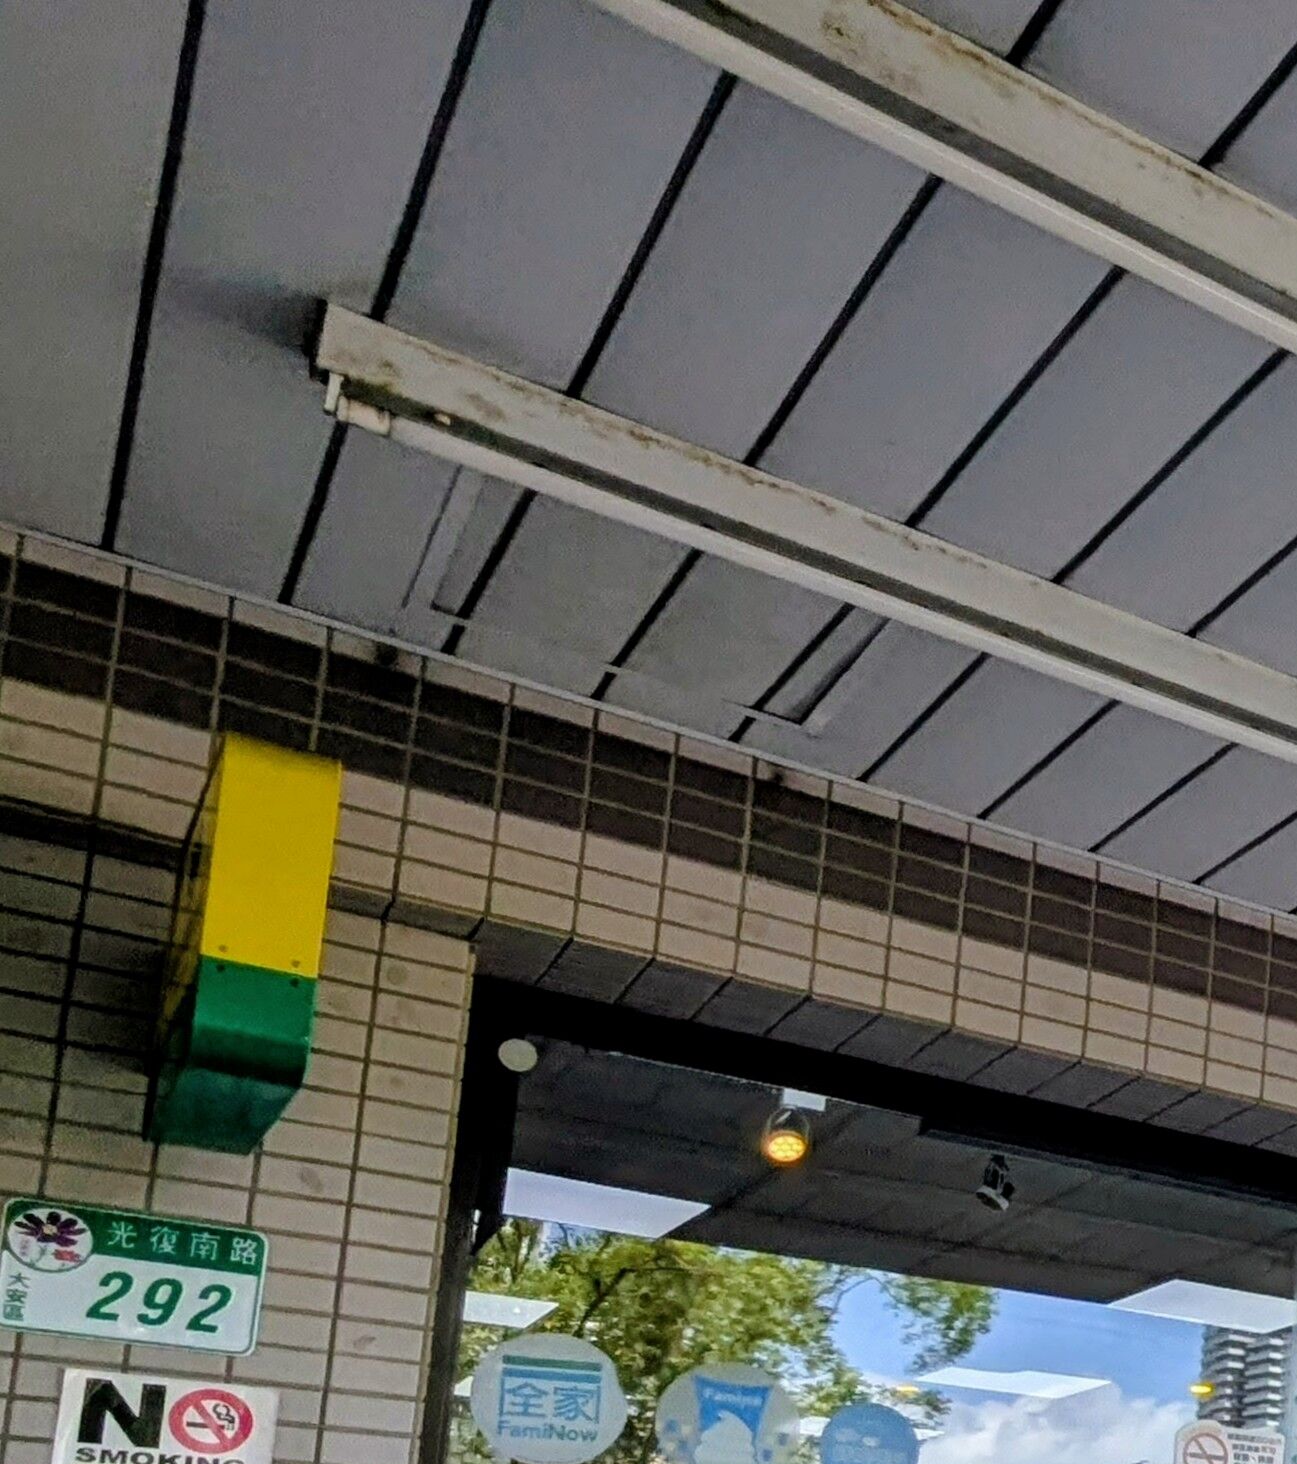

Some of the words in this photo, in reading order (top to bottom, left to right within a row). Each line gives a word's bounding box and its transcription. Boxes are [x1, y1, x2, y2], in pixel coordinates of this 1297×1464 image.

[107, 1220, 258, 1266] 光復南路
[3, 1271, 30, 1321] 大安區
[86, 1271, 233, 1333] 292
[504, 1381, 598, 1424] 全家
[497, 1421, 598, 1443] FamiNow
